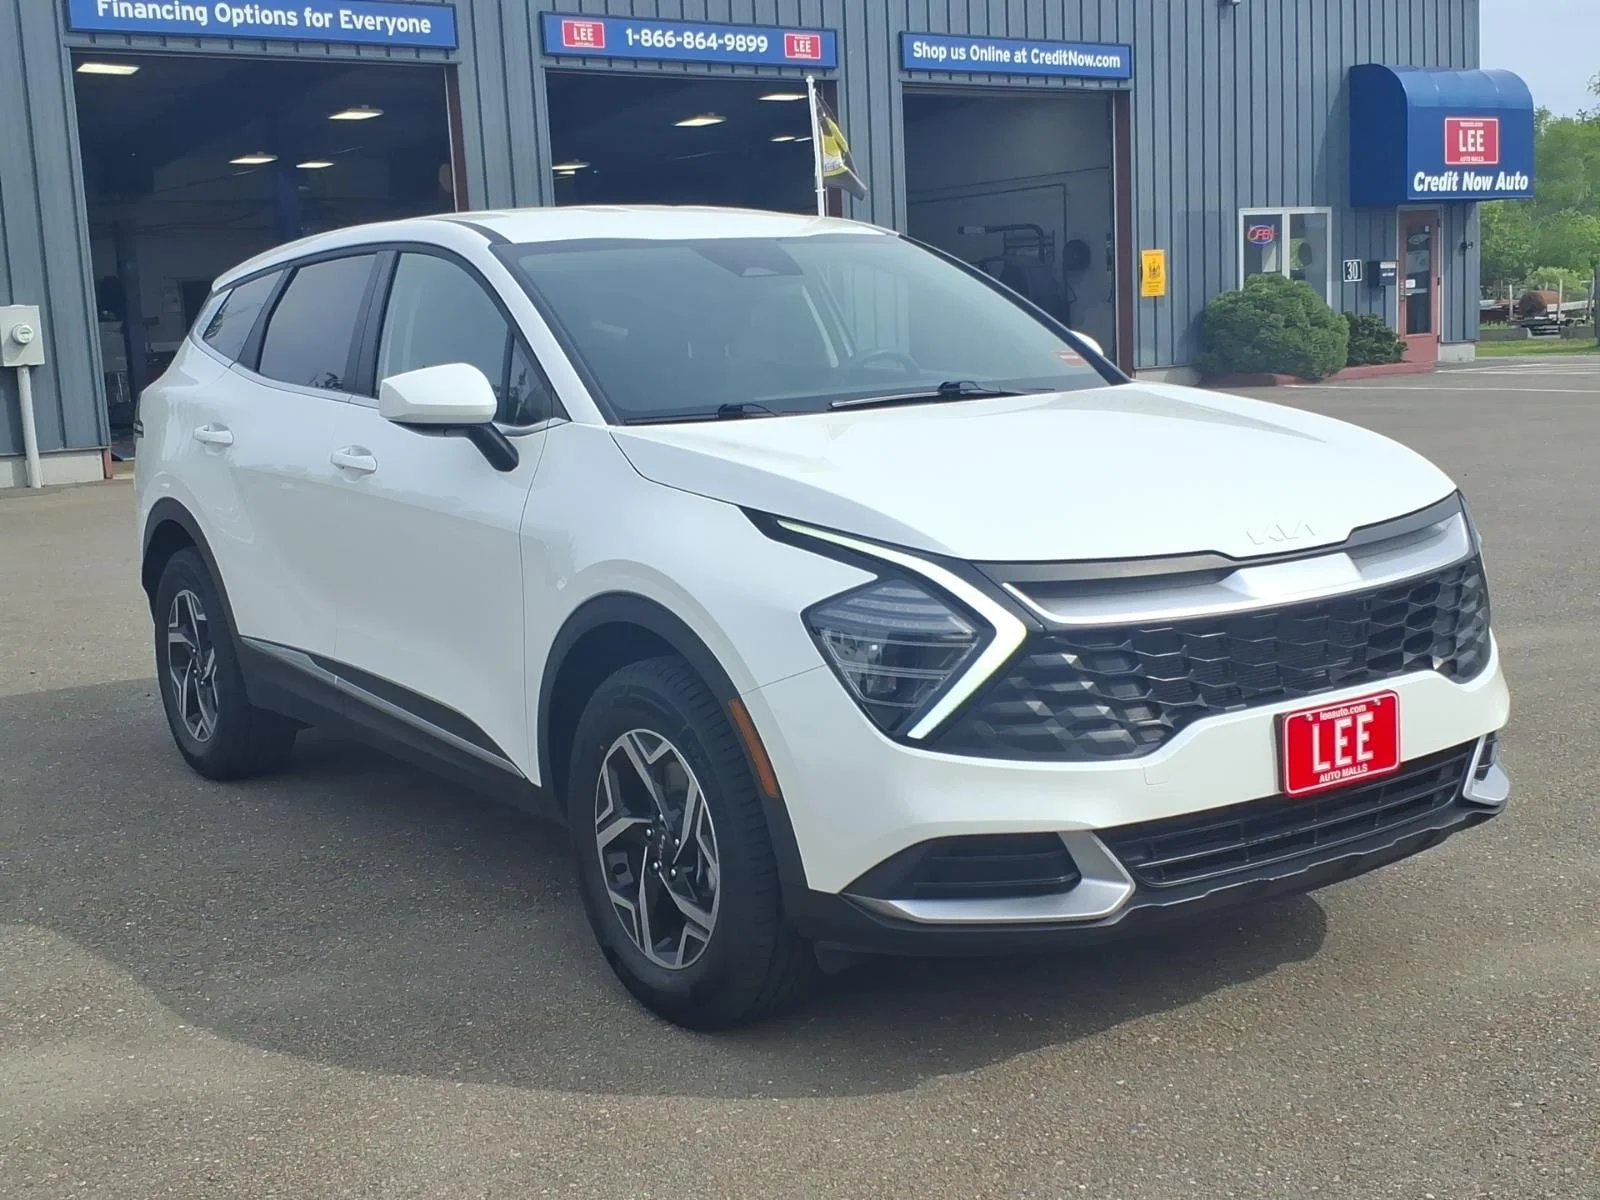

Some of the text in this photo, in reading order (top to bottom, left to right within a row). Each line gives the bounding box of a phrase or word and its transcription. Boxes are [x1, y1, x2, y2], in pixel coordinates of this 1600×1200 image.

[97, 0, 432, 35] Financing Options for Everyone
[573, 27, 594, 41] LEE
[625, 27, 768, 53] 1-866-864-9899
[793, 39, 811, 53] LEE
[912, 41, 1121, 68] Shop us Online at CreditNow.com
[1458, 129, 1485, 152] LEE
[1413, 171, 1529, 192] Credit Now Auto
[1346, 261, 1359, 280] 30
[1312, 711, 1375, 773] LEE
[1320, 763, 1368, 784] AUTO MALLS
